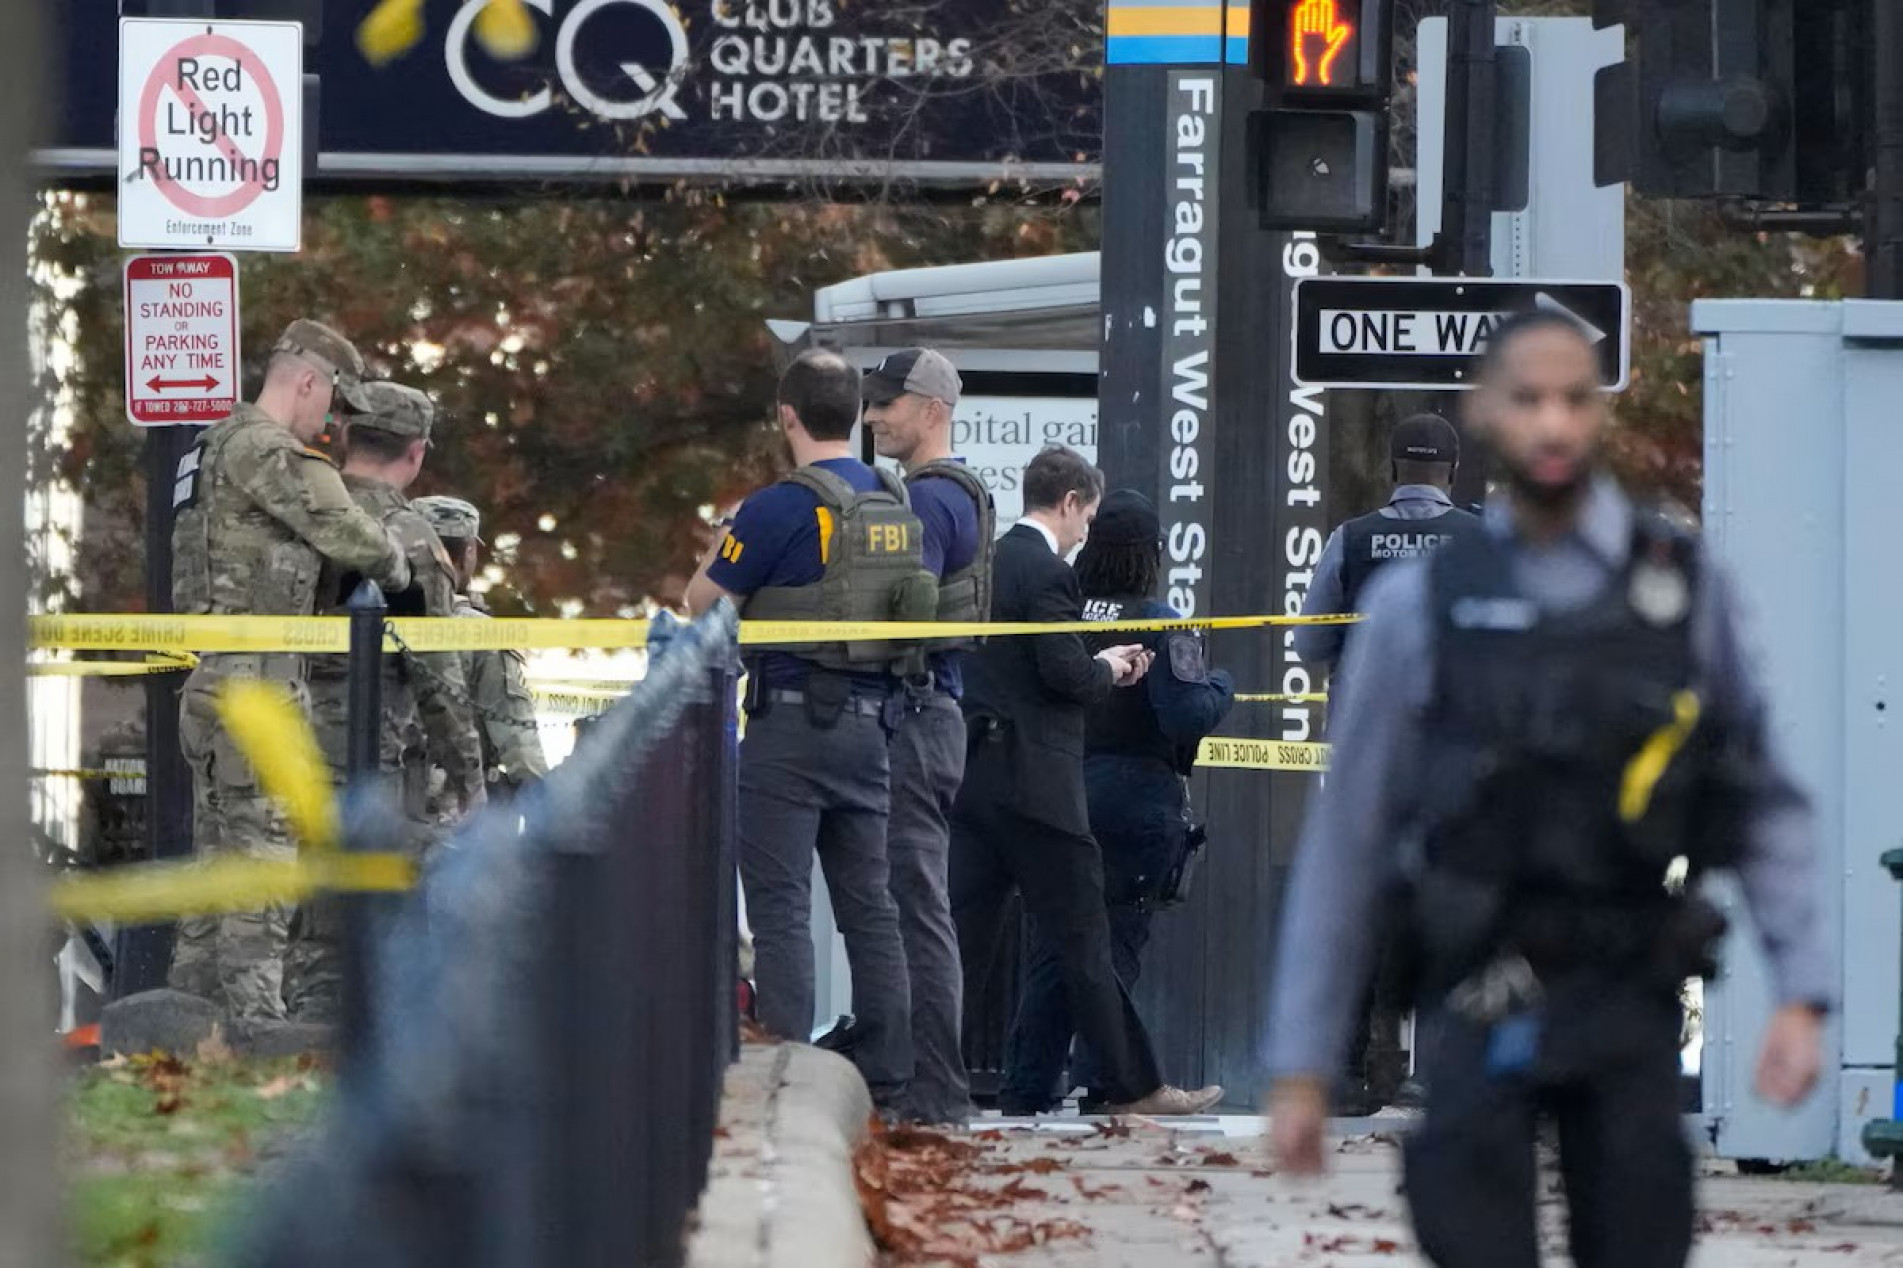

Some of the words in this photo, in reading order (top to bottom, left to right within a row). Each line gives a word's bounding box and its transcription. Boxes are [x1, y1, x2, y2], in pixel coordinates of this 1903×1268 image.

[711, 0, 835, 28] CLUB
[445, 0, 688, 119] CQ
[710, 35, 974, 77] QUARTERS
[176, 57, 241, 92] Red
[711, 81, 868, 122] HOTEL
[167, 102, 253, 144] Light
[138, 147, 280, 191] Running
[1165, 78, 1215, 338] Farragut
[166, 219, 226, 235] Enforcement
[230, 221, 253, 236] Zone
[151, 262, 174, 275] TOW
[176, 261, 210, 274] AWAY
[169, 282, 192, 298] NO
[140, 302, 223, 318] STANDING
[174, 321, 188, 331] OR
[1331, 313, 1416, 352] ONE
[145, 334, 219, 351] PARKING
[140, 355, 177, 370] ANY
[187, 352, 225, 369] TIME
[134, 401, 142, 412] IF
[145, 401, 171, 413] TOWED
[1170, 350, 1209, 502] West
[868, 523, 909, 553] FBI
[1371, 549, 1416, 559] MOTOR
[1207, 742, 1231, 761] LINE
[1233, 743, 1268, 763] POLICE
[1278, 745, 1312, 765] CROSS
